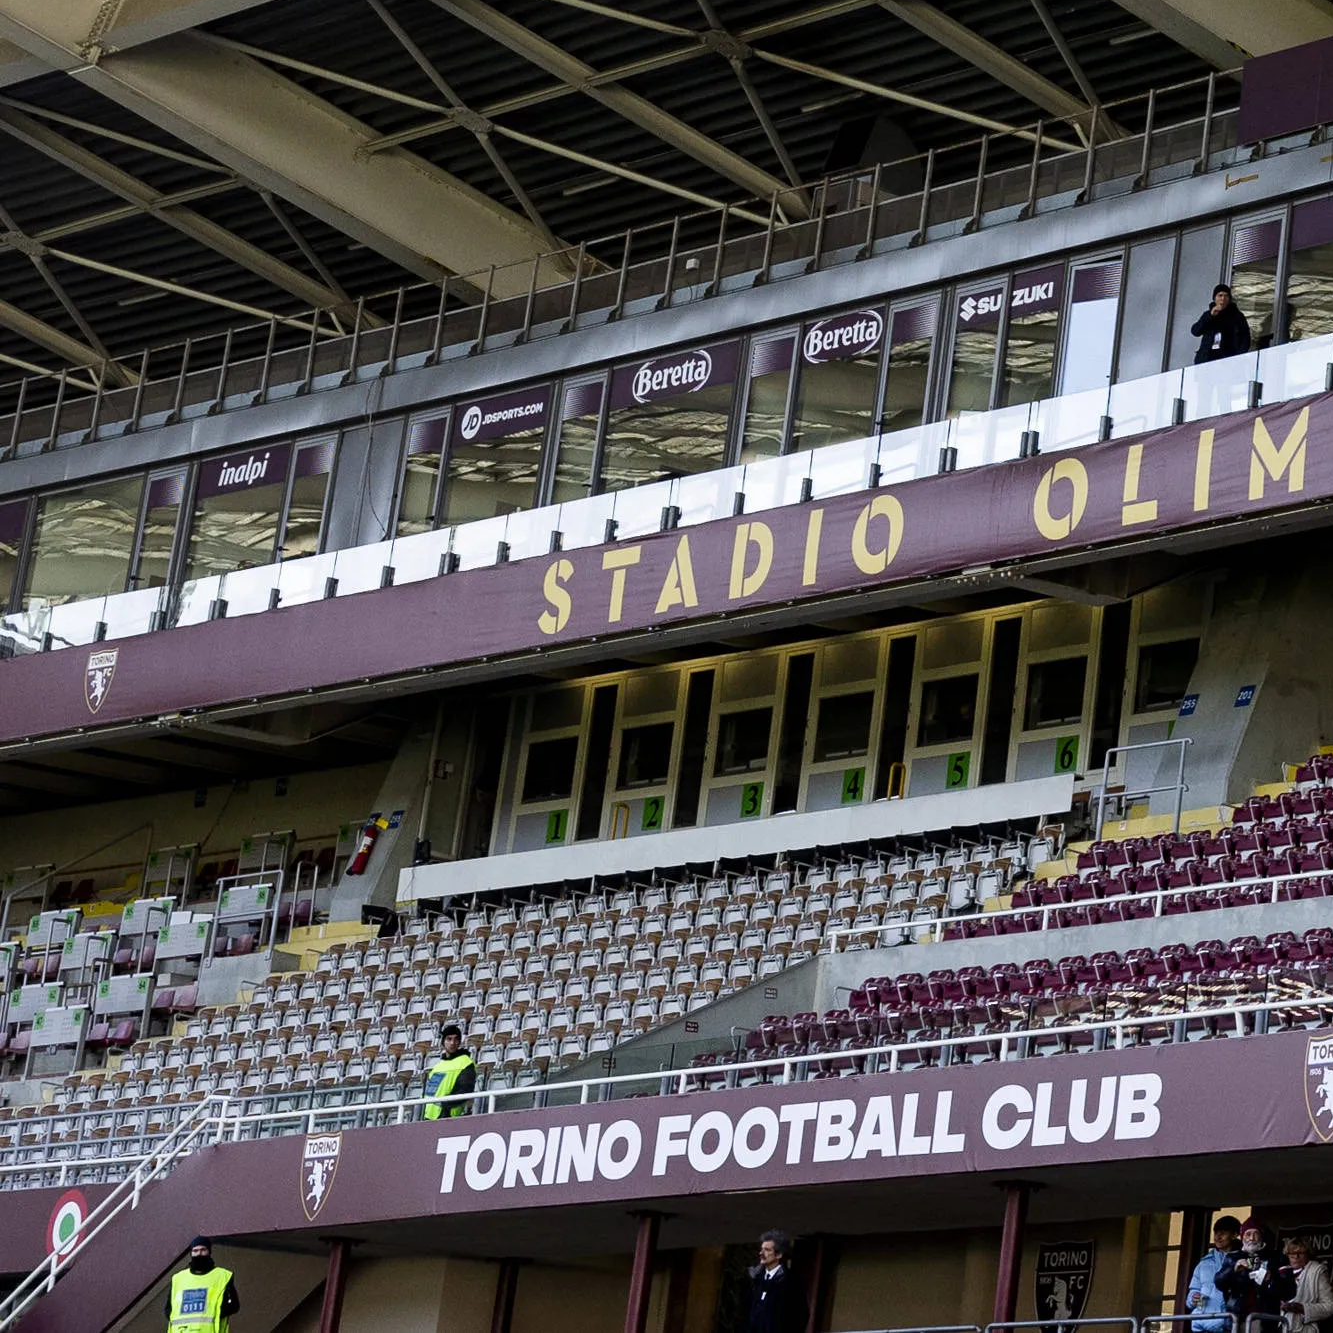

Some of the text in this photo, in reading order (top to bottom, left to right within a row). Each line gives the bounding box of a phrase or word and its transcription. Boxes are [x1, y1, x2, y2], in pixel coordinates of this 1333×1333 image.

[977, 281, 1054, 315] SUZUKI
[806, 319, 879, 357] Beretta
[636, 355, 708, 397] Beretta
[482, 402, 544, 426] JDSPORTS.COM
[218, 452, 270, 487] inalpi
[539, 495, 904, 635] STADIO
[1060, 739, 1074, 770] 6
[846, 770, 860, 801] 4
[952, 755, 965, 787] 5
[646, 798, 660, 828] 2
[744, 784, 759, 815] 3
[550, 812, 562, 840] 1
[308, 1140, 338, 1155] TORINO
[436, 1072, 1163, 1194] TORINO FOOTBALL CLUB
[323, 1158, 335, 1172] FC
[1043, 1250, 1088, 1268] TORINO
[1068, 1275, 1085, 1290] FC
